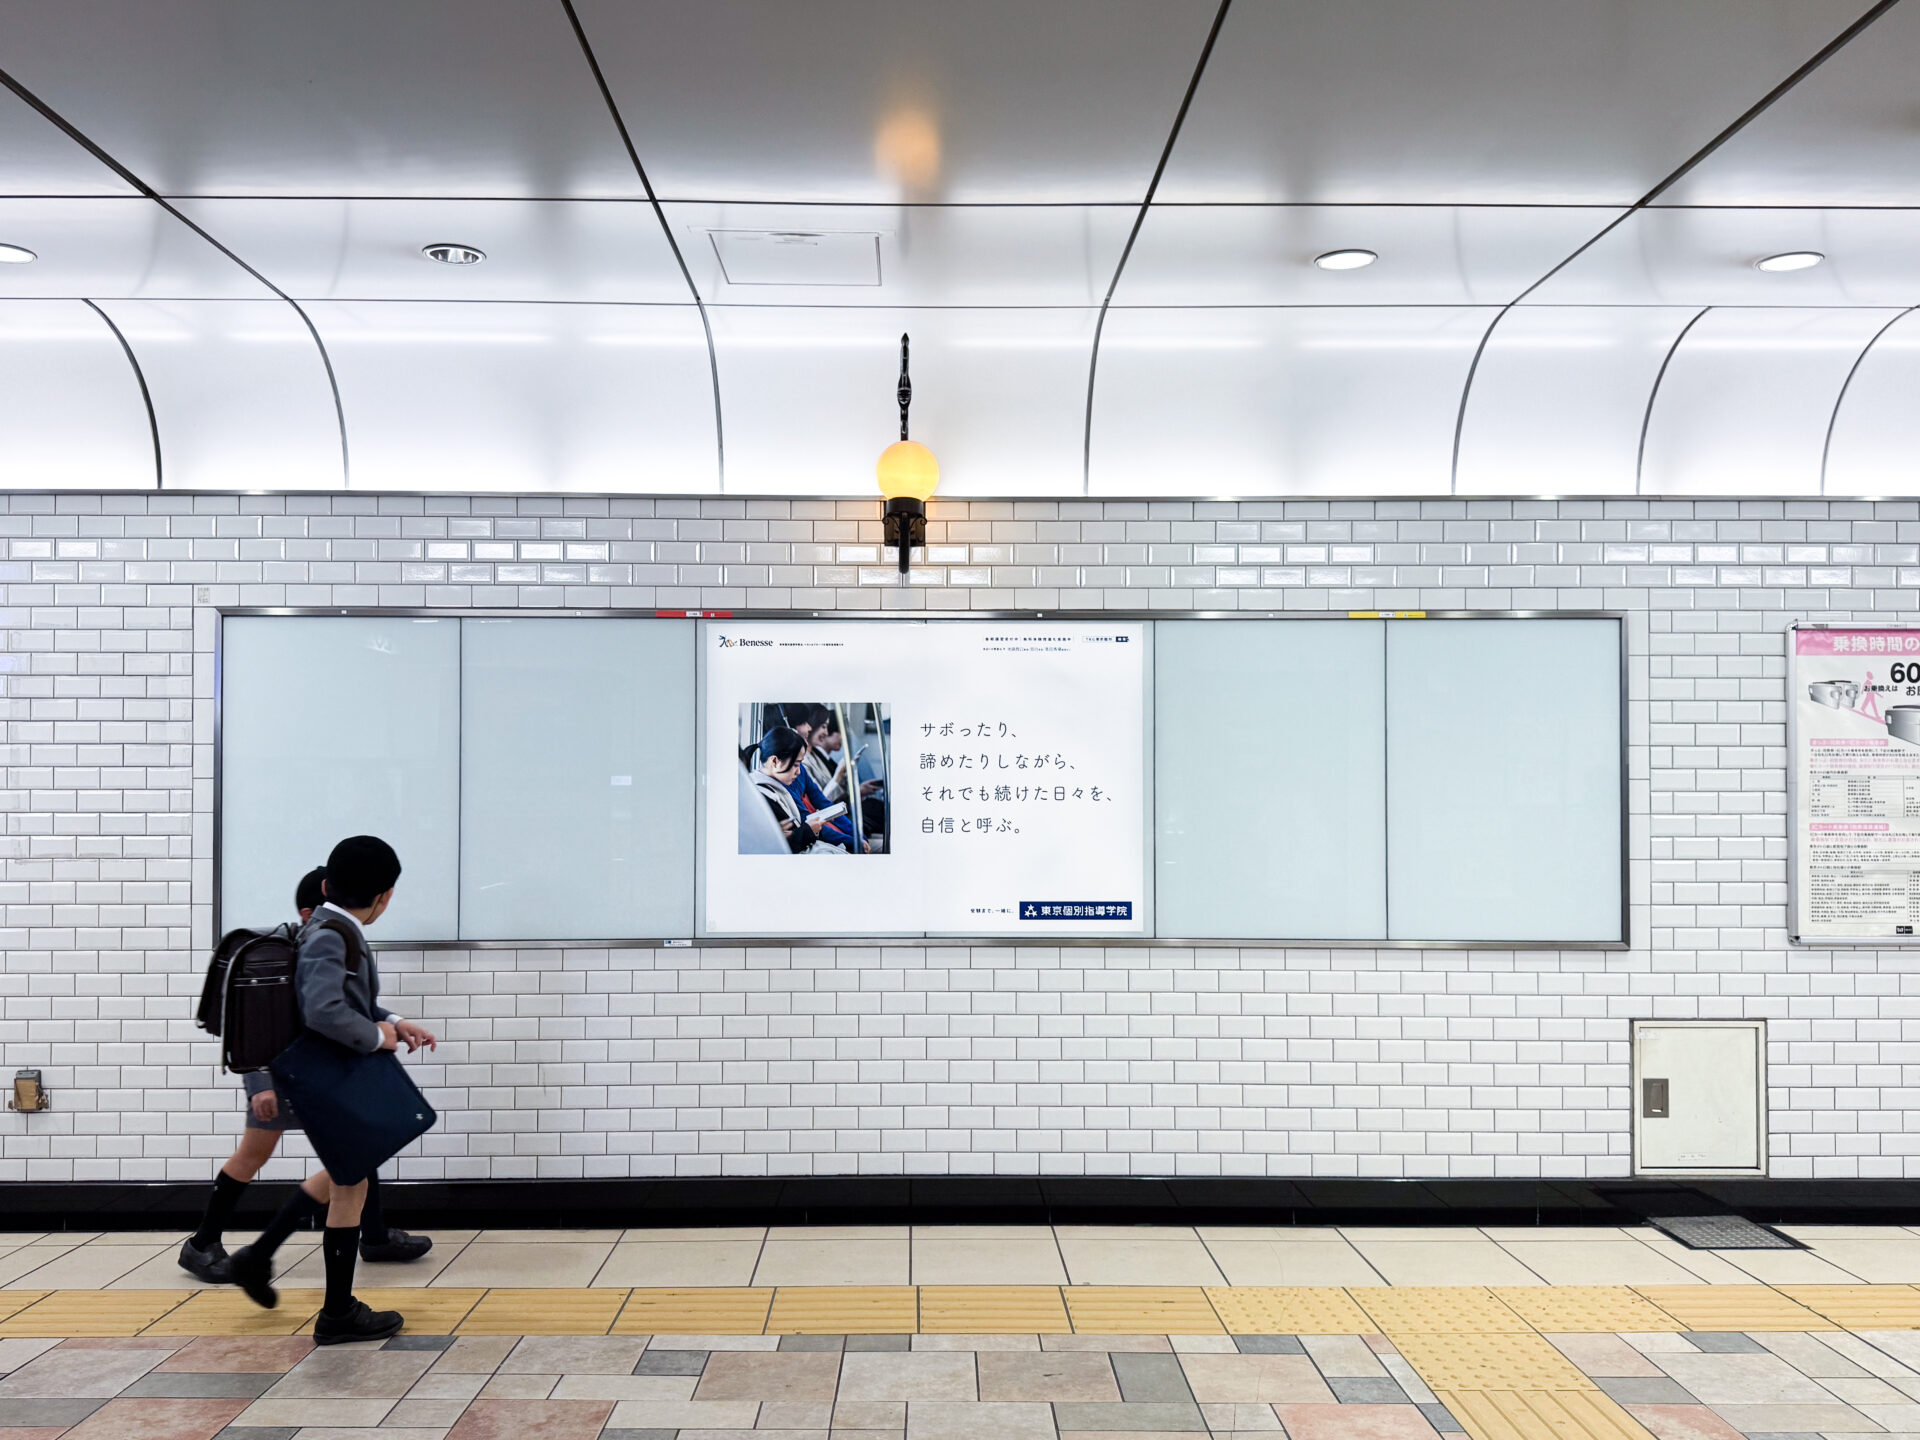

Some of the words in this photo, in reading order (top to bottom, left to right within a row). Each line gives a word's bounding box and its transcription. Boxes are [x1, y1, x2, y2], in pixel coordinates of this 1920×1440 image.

[739, 638, 774, 647] Benesse
[1833, 636, 1920, 652] 乗換時間の
[1890, 662, 1920, 683] 60
[920, 722, 1017, 738] サボったり、
[920, 753, 1075, 770] 諦めたりしながら、
[921, 785, 1112, 802] それでも続けた日々を、
[921, 816, 1021, 834] 自信と呼ぶ。
[1040, 905, 1128, 917] 東京個別指導学院
